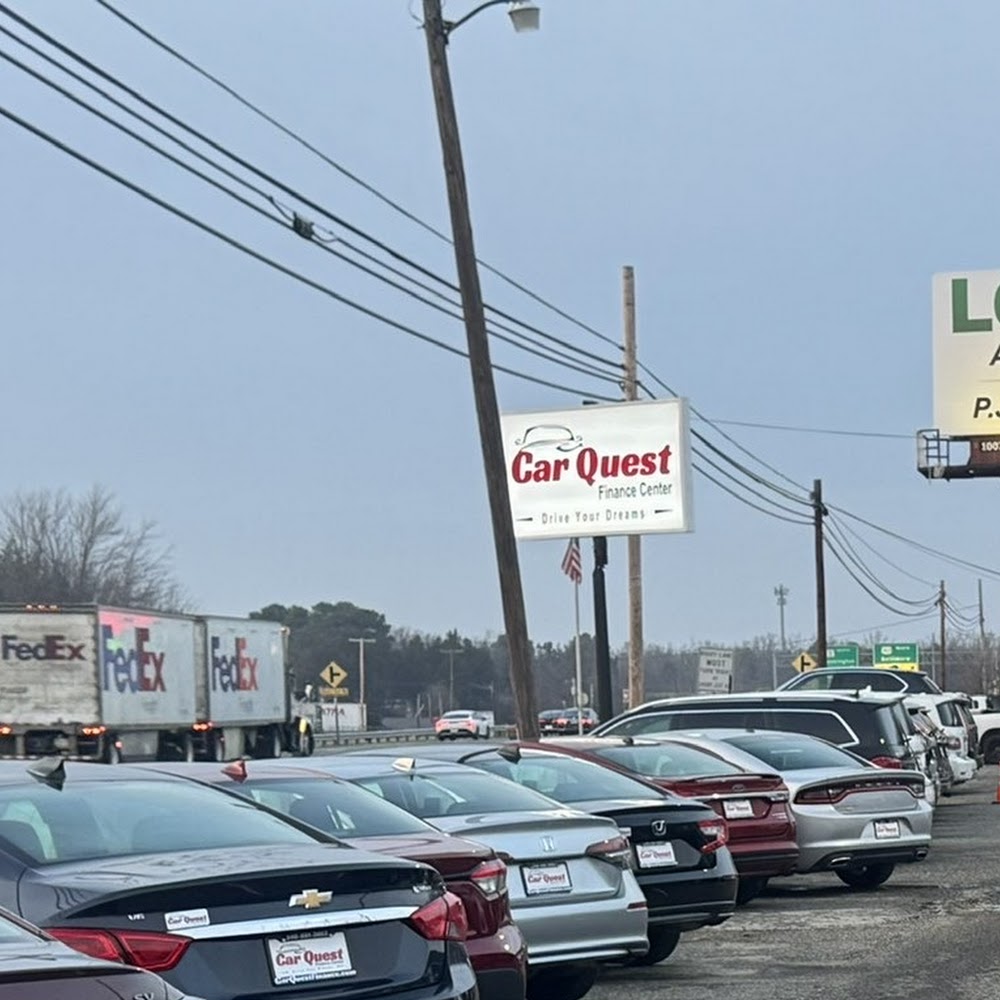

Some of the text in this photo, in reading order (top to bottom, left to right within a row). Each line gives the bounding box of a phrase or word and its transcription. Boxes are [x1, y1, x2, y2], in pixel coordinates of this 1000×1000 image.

[512, 444, 672, 487] Car Quest
[599, 481, 672, 500] Finance Center
[542, 508, 646, 524] Drive Your Dreams
[1, 634, 87, 660] FedEx
[101, 624, 166, 693] FedEx
[211, 636, 258, 692] FedEx
[276, 953, 301, 966] Car
[303, 948, 343, 966] Quest
